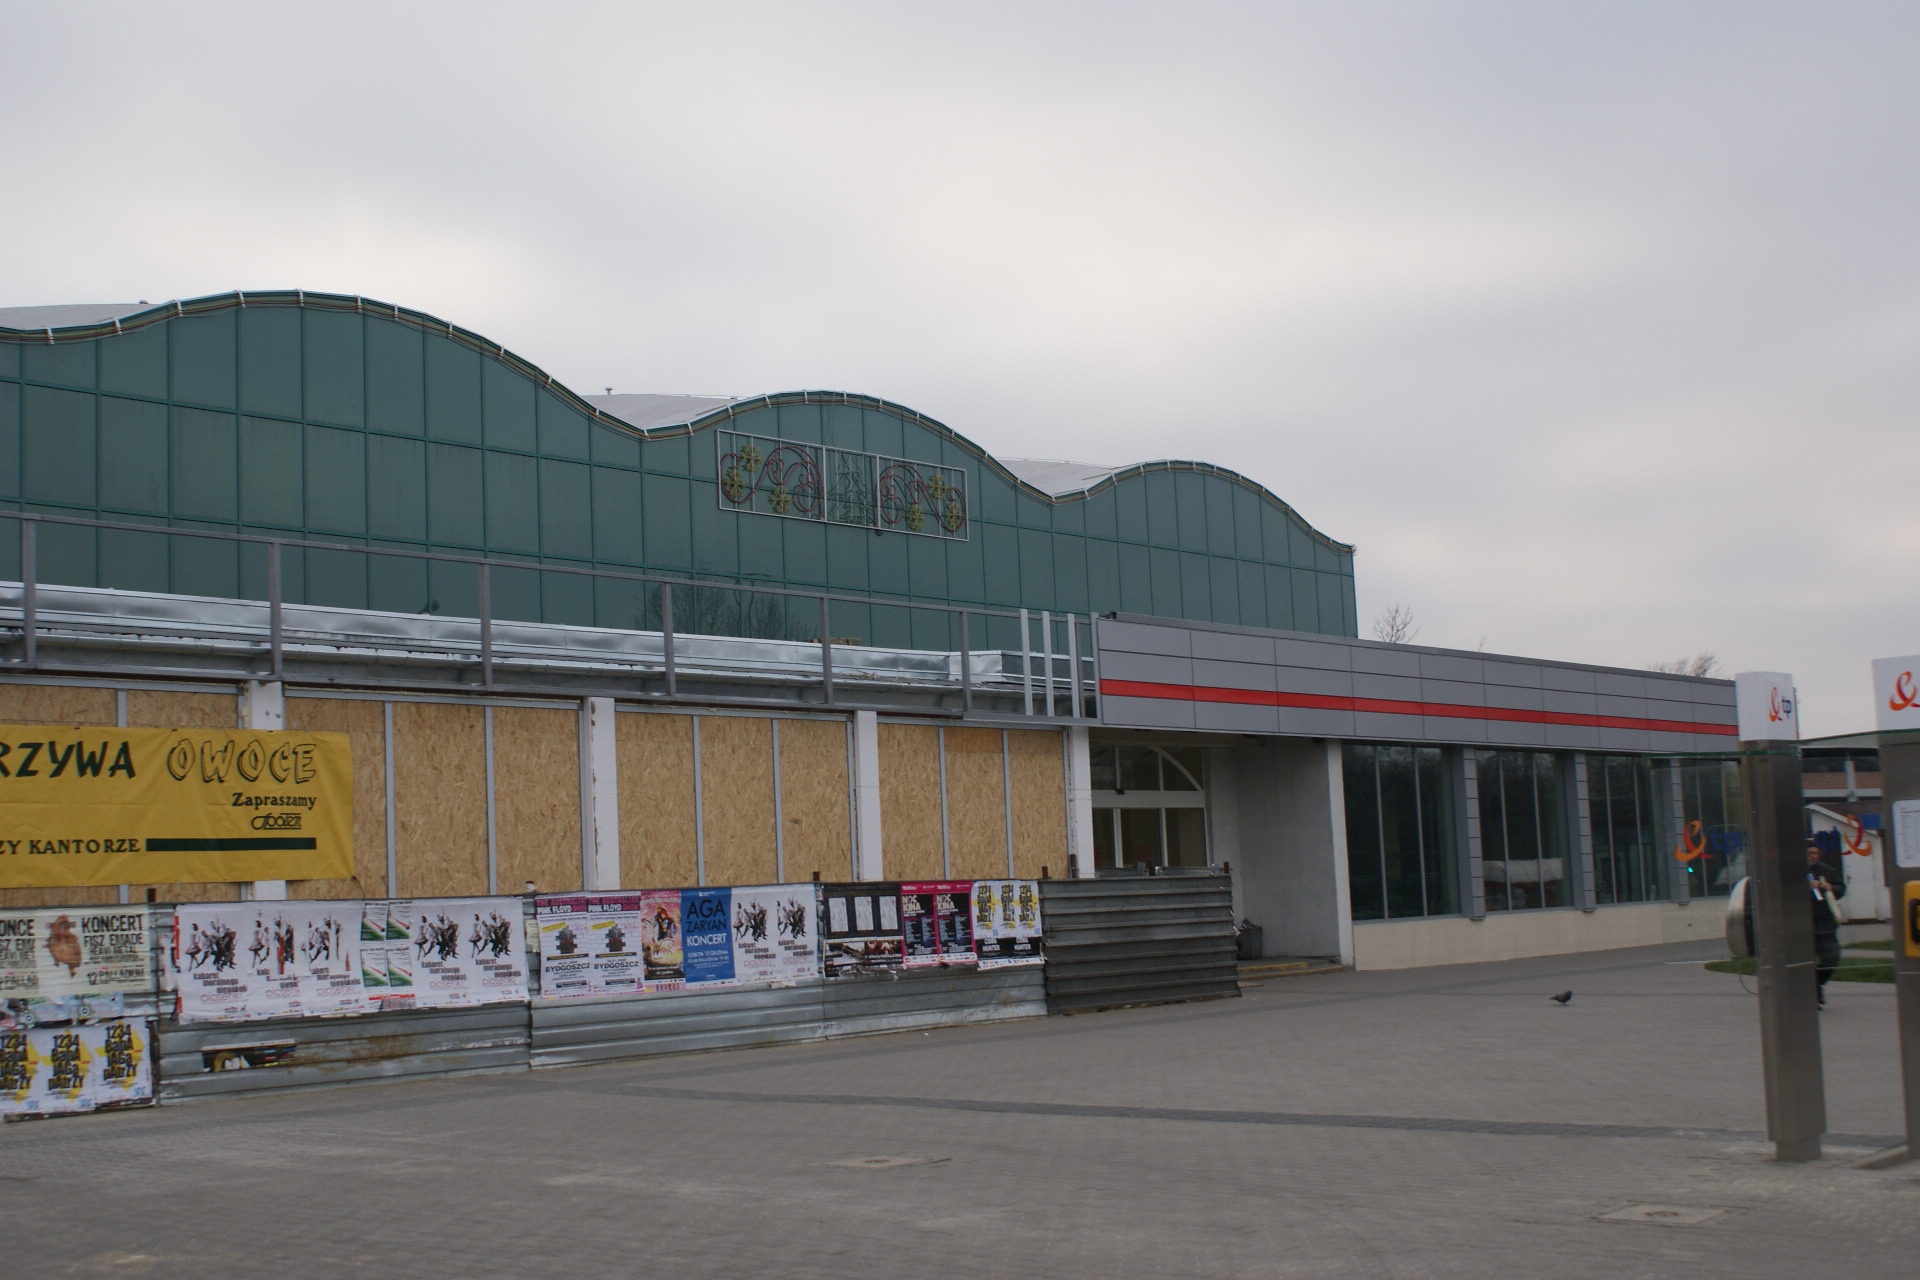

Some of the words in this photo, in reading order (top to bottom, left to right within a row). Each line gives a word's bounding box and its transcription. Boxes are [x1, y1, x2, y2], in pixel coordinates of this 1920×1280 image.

[0, 741, 136, 779] RZYWA
[167, 738, 317, 784] OWOCE
[232, 792, 317, 810] Zapraszamy
[29, 838, 140, 854] KANTORZE
[552, 904, 572, 913] FLOYD
[603, 903, 622, 911] FLOYD
[687, 899, 726, 919] AGA
[81, 914, 143, 934] KONCERT
[686, 919, 727, 933] ZARYAN
[109, 933, 143, 946] EMADE
[687, 933, 727, 947] KONCERT
[545, 962, 590, 973] BYDGOSZCZ
[594, 961, 639, 970] BYDGOSZCZ
[105, 1024, 131, 1039] 1234
